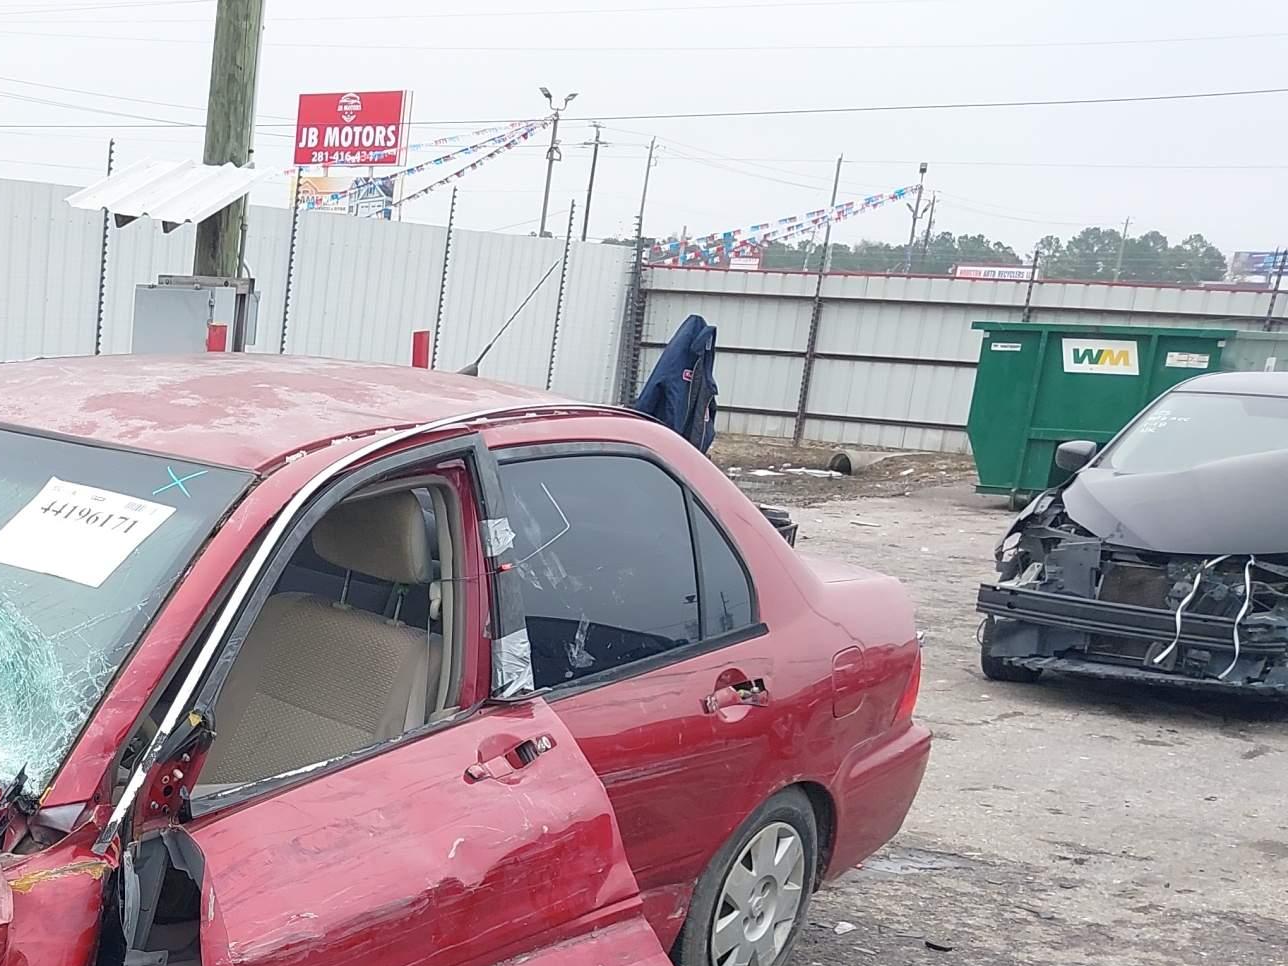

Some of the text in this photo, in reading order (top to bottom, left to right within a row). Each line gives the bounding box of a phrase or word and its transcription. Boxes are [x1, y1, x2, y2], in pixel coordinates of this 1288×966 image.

[299, 126, 397, 148] JB MOTORS
[1072, 348, 1130, 366] WM
[41, 500, 139, 534] 44196171
